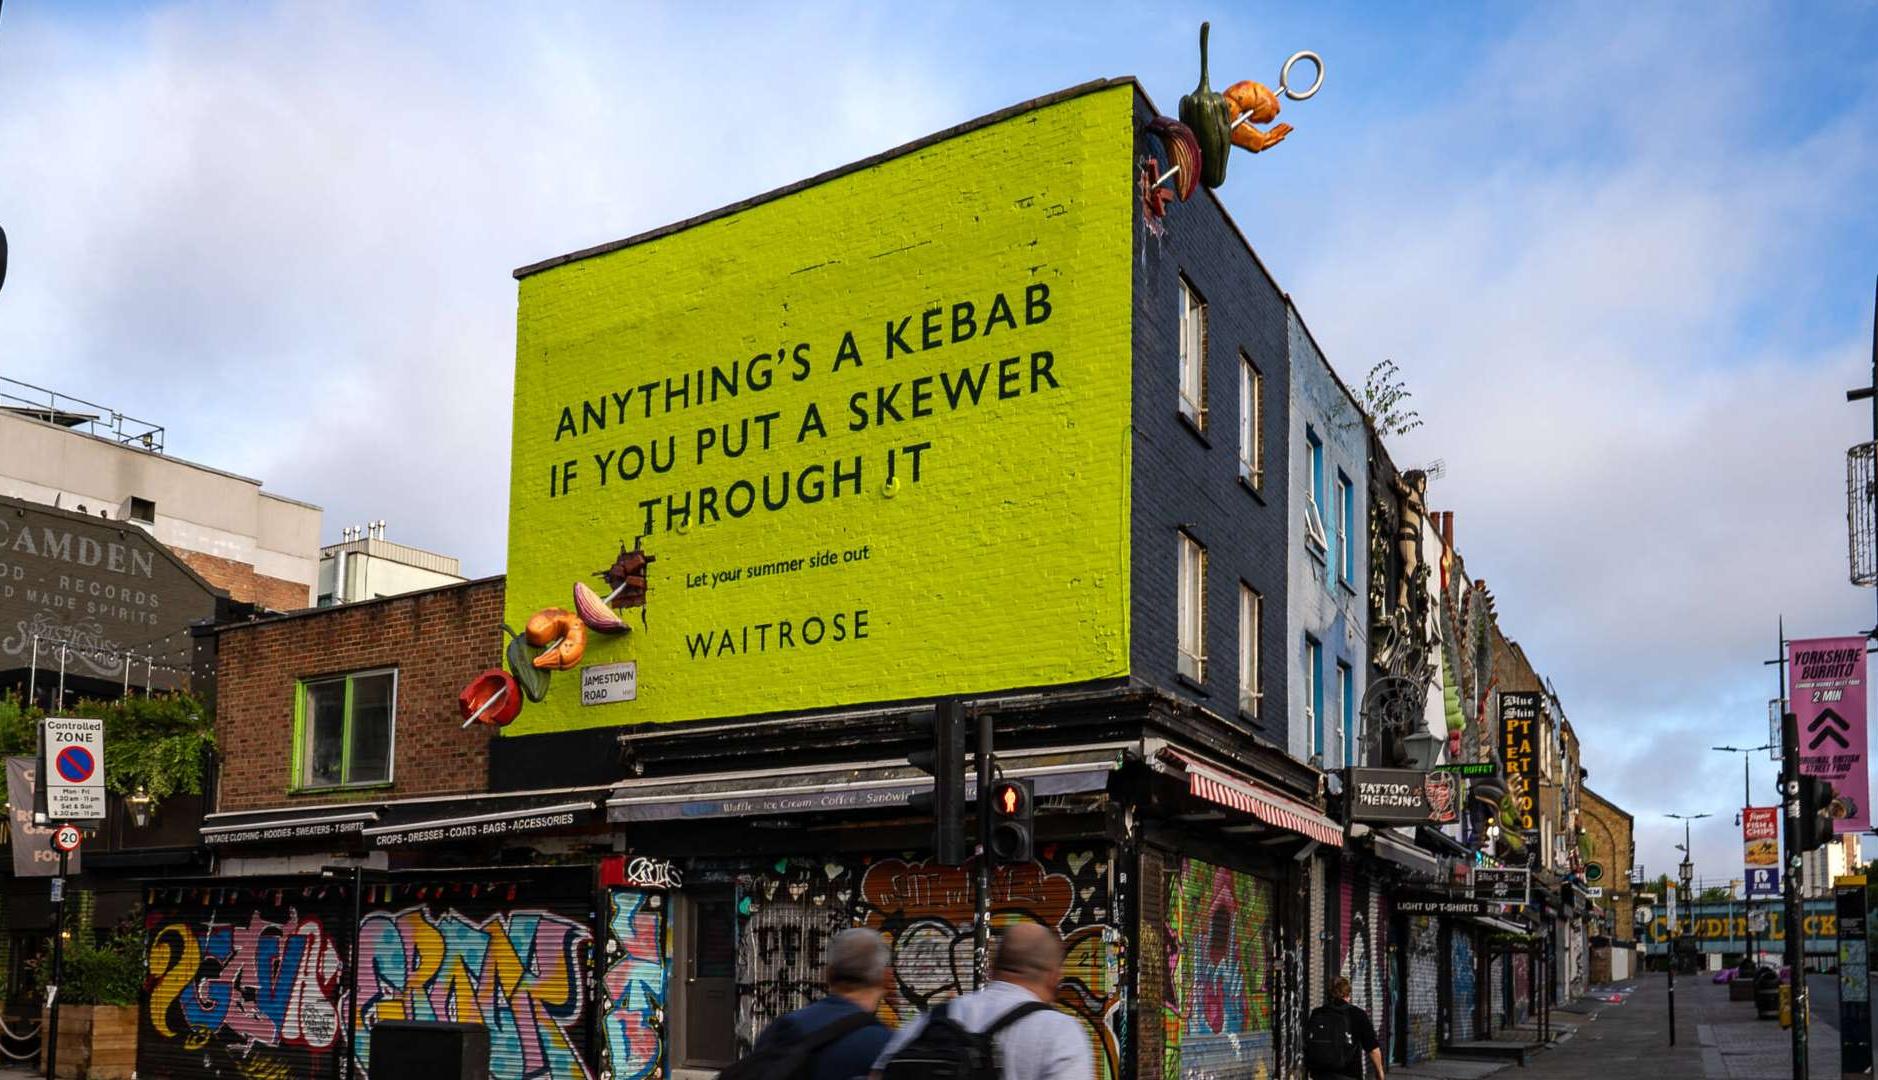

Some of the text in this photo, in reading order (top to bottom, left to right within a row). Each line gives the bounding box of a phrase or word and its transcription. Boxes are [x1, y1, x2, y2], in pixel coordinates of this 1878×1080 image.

[832, 331, 863, 373] A
[886, 283, 1052, 360] KEBAB
[550, 351, 1060, 498] IF YOU PUT A SKEWER
[639, 442, 931, 535] THROUGH IT
[686, 545, 870, 589] Let your summer side out
[60, 576, 160, 608] RECORDS
[27, 590, 76, 609] MADE
[87, 601, 158, 625] SPIRITS
[686, 610, 869, 660] WAITROSE
[1794, 648, 1863, 666] YORKSHIRE
[584, 671, 634, 687] JAMESTOWN
[1801, 663, 1855, 680] BURRITO
[584, 689, 607, 700] ROAD
[1813, 690, 1843, 702] 2 MIN
[48, 721, 101, 731] Controlled
[56, 732, 94, 743] ZONE
[1506, 719, 1521, 773] PIER
[1519, 719, 1533, 829] TATTOO
[723, 789, 915, 812] Waffle Ice Cream Coffee Sandwic
[1359, 783, 1410, 795] TATTOO
[1359, 794, 1422, 807] PIERCING
[61, 833, 77, 843] 20
[205, 833, 229, 844] VINTAGE
[230, 831, 260, 842] CLOTHING
[264, 828, 292, 838] HOODIES
[296, 824, 330, 837] SWEATERS
[340, 821, 364, 833] SHIRTS
[376, 834, 403, 846] CROPS
[408, 829, 444, 843] DRESSES
[450, 825, 477, 838] COATS
[483, 822, 507, 834] BAGS
[513, 813, 574, 830] ACCESSORIES
[1397, 902, 1423, 911] LIGHT
[1425, 903, 1438, 911] UP
[1440, 903, 1479, 913] T-SHIRTS
[1650, 914, 1756, 942] CDE
[1769, 912, 1837, 940] LCK
